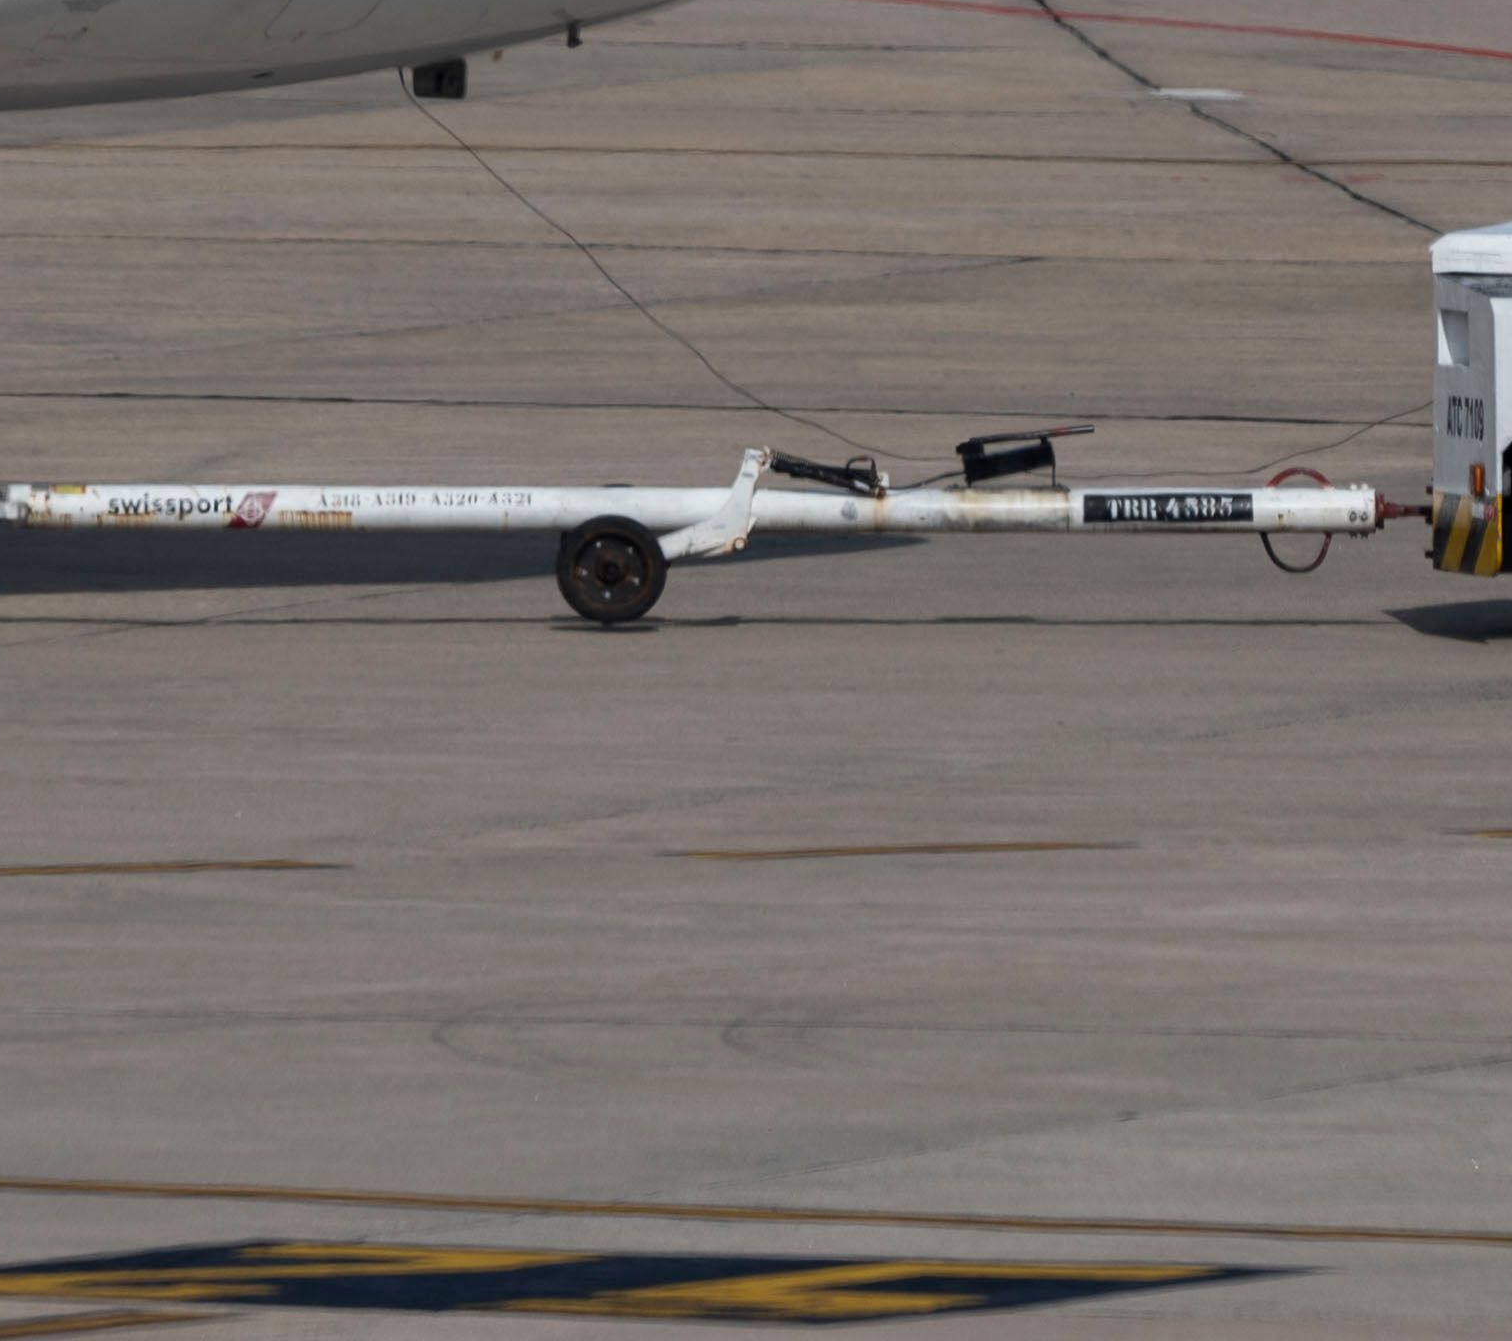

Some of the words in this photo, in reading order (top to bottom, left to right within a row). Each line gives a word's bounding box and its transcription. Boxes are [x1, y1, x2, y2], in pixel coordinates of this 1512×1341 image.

[1446, 395, 1463, 438] ATC
[1464, 396, 1485, 442] 7109
[108, 492, 234, 521] swissport
